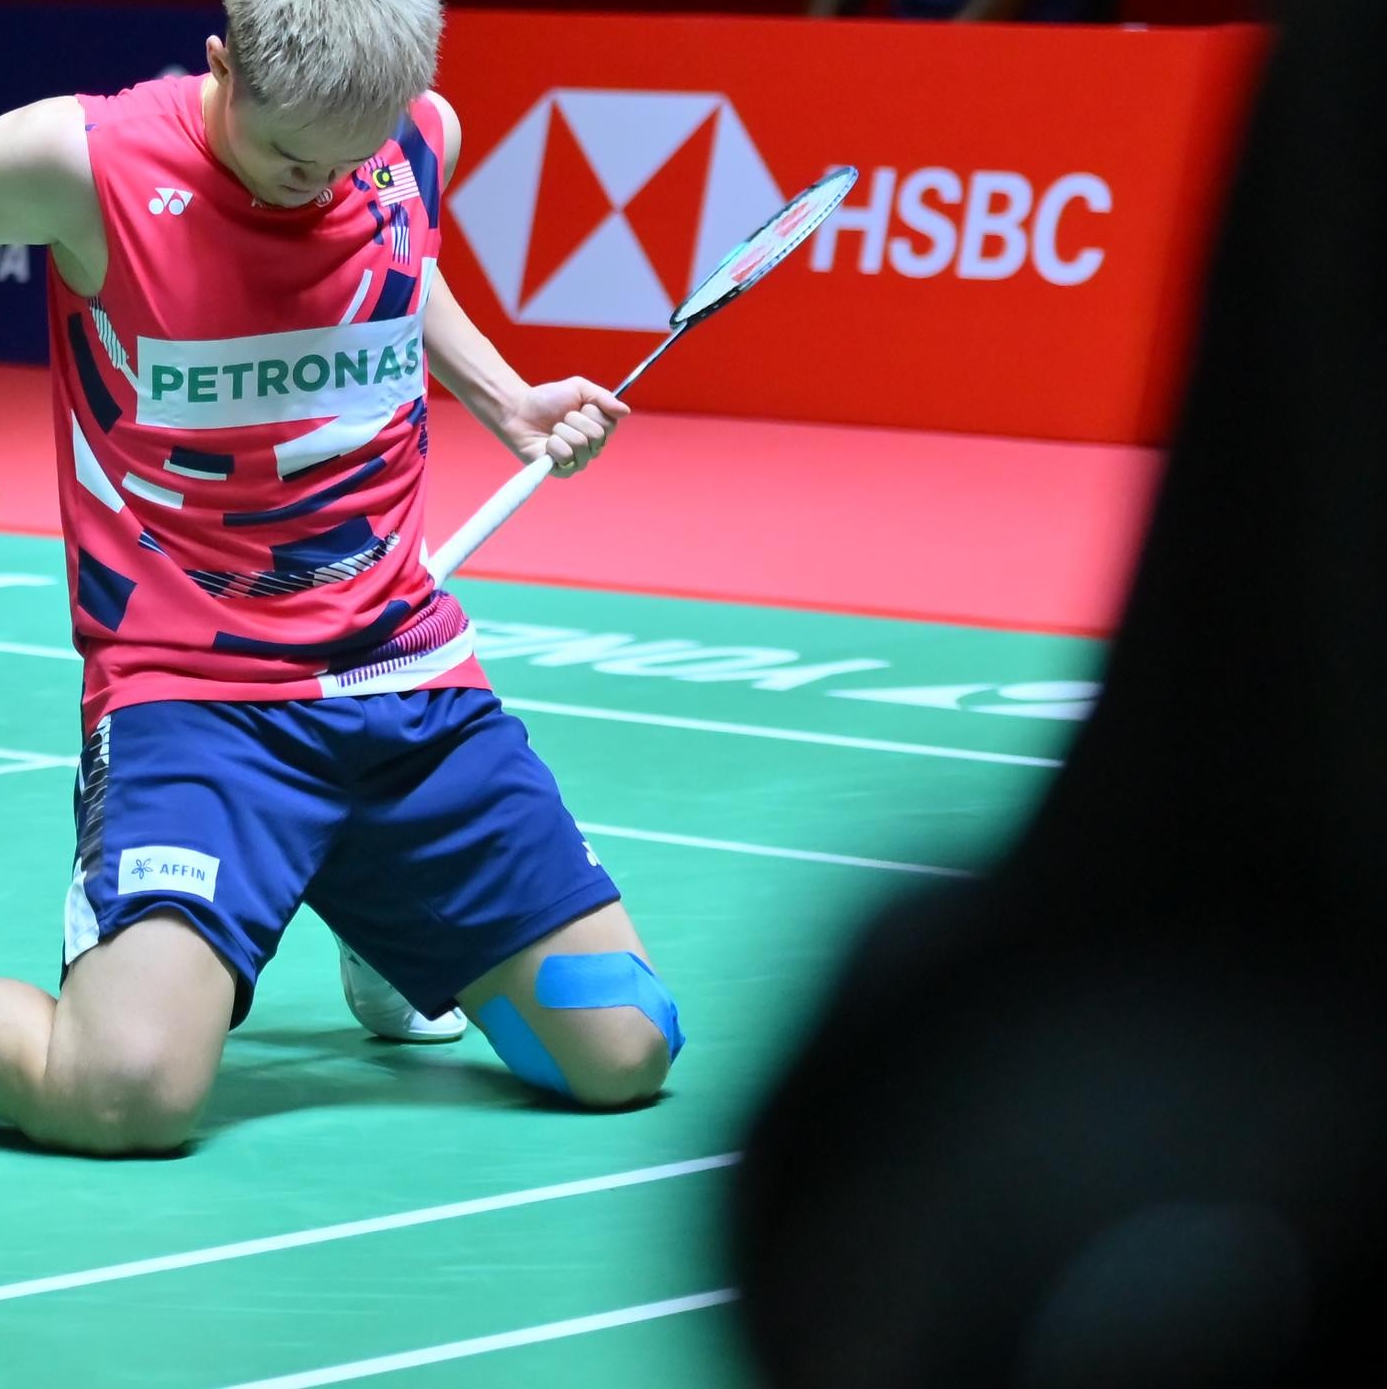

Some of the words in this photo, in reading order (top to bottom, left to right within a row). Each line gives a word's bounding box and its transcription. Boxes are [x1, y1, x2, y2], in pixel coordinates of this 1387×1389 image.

[808, 164, 1114, 288] HSBC
[151, 337, 420, 404] PETRONAS
[159, 862, 206, 882] AFFIN
